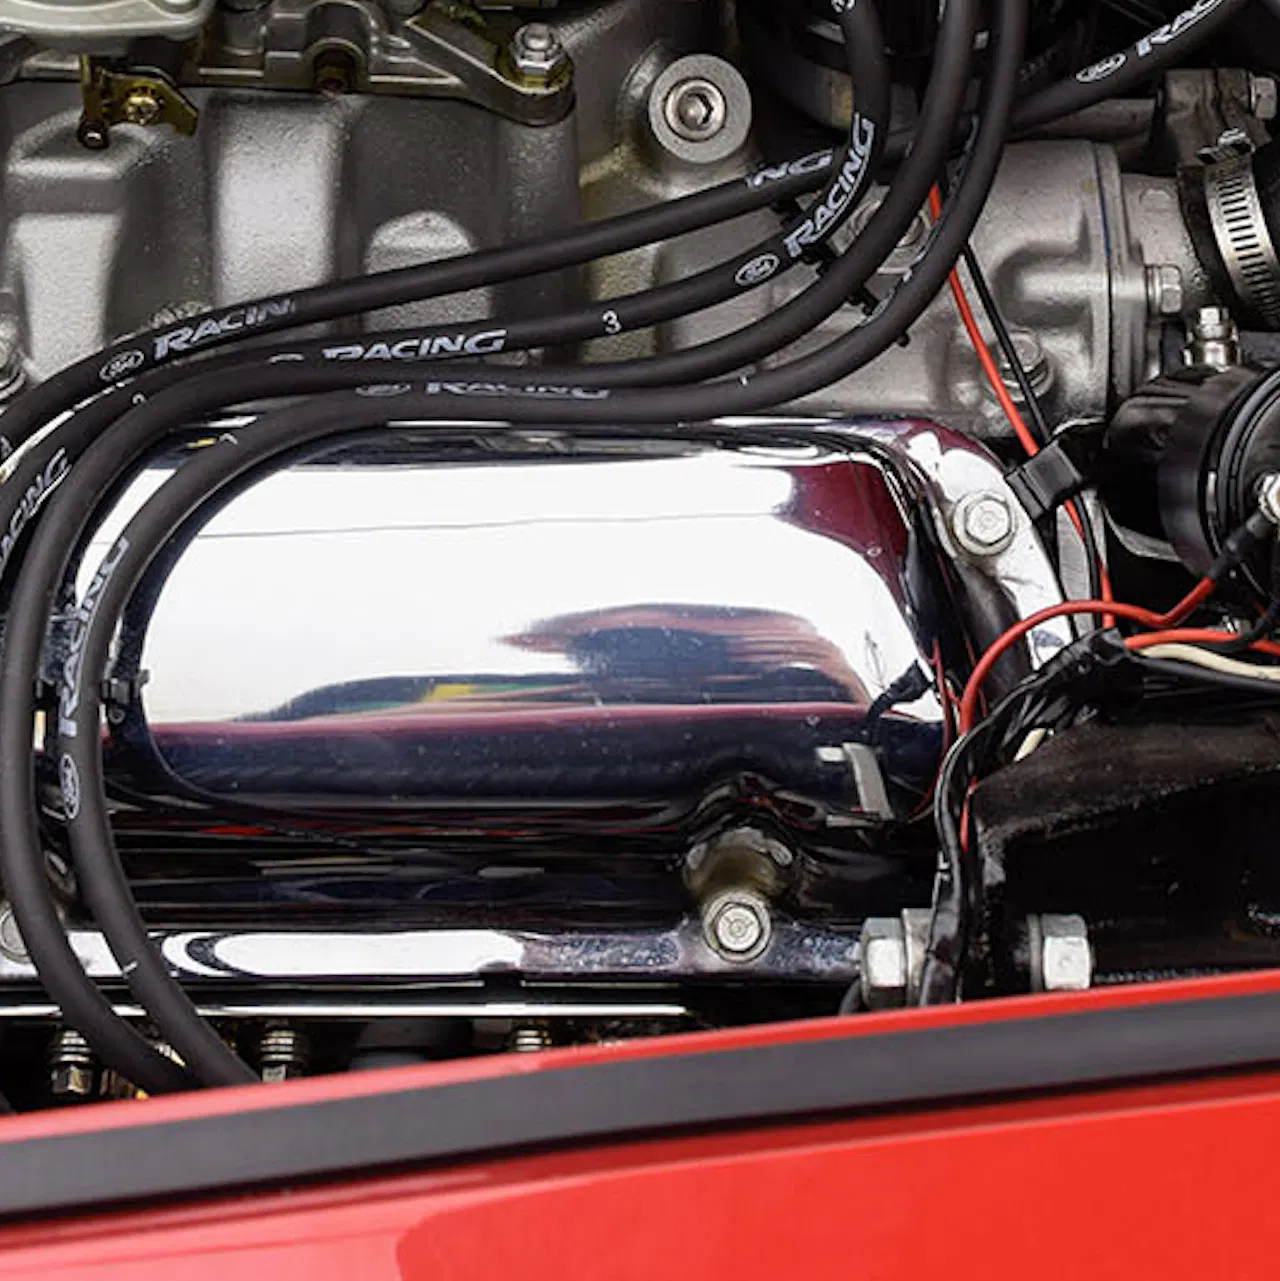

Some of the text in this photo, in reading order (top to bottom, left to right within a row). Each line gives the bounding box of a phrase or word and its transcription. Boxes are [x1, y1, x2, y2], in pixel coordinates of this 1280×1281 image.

[783, 111, 875, 258] RACING
[602, 309, 622, 334] 3
[321, 328, 508, 362] RACING
